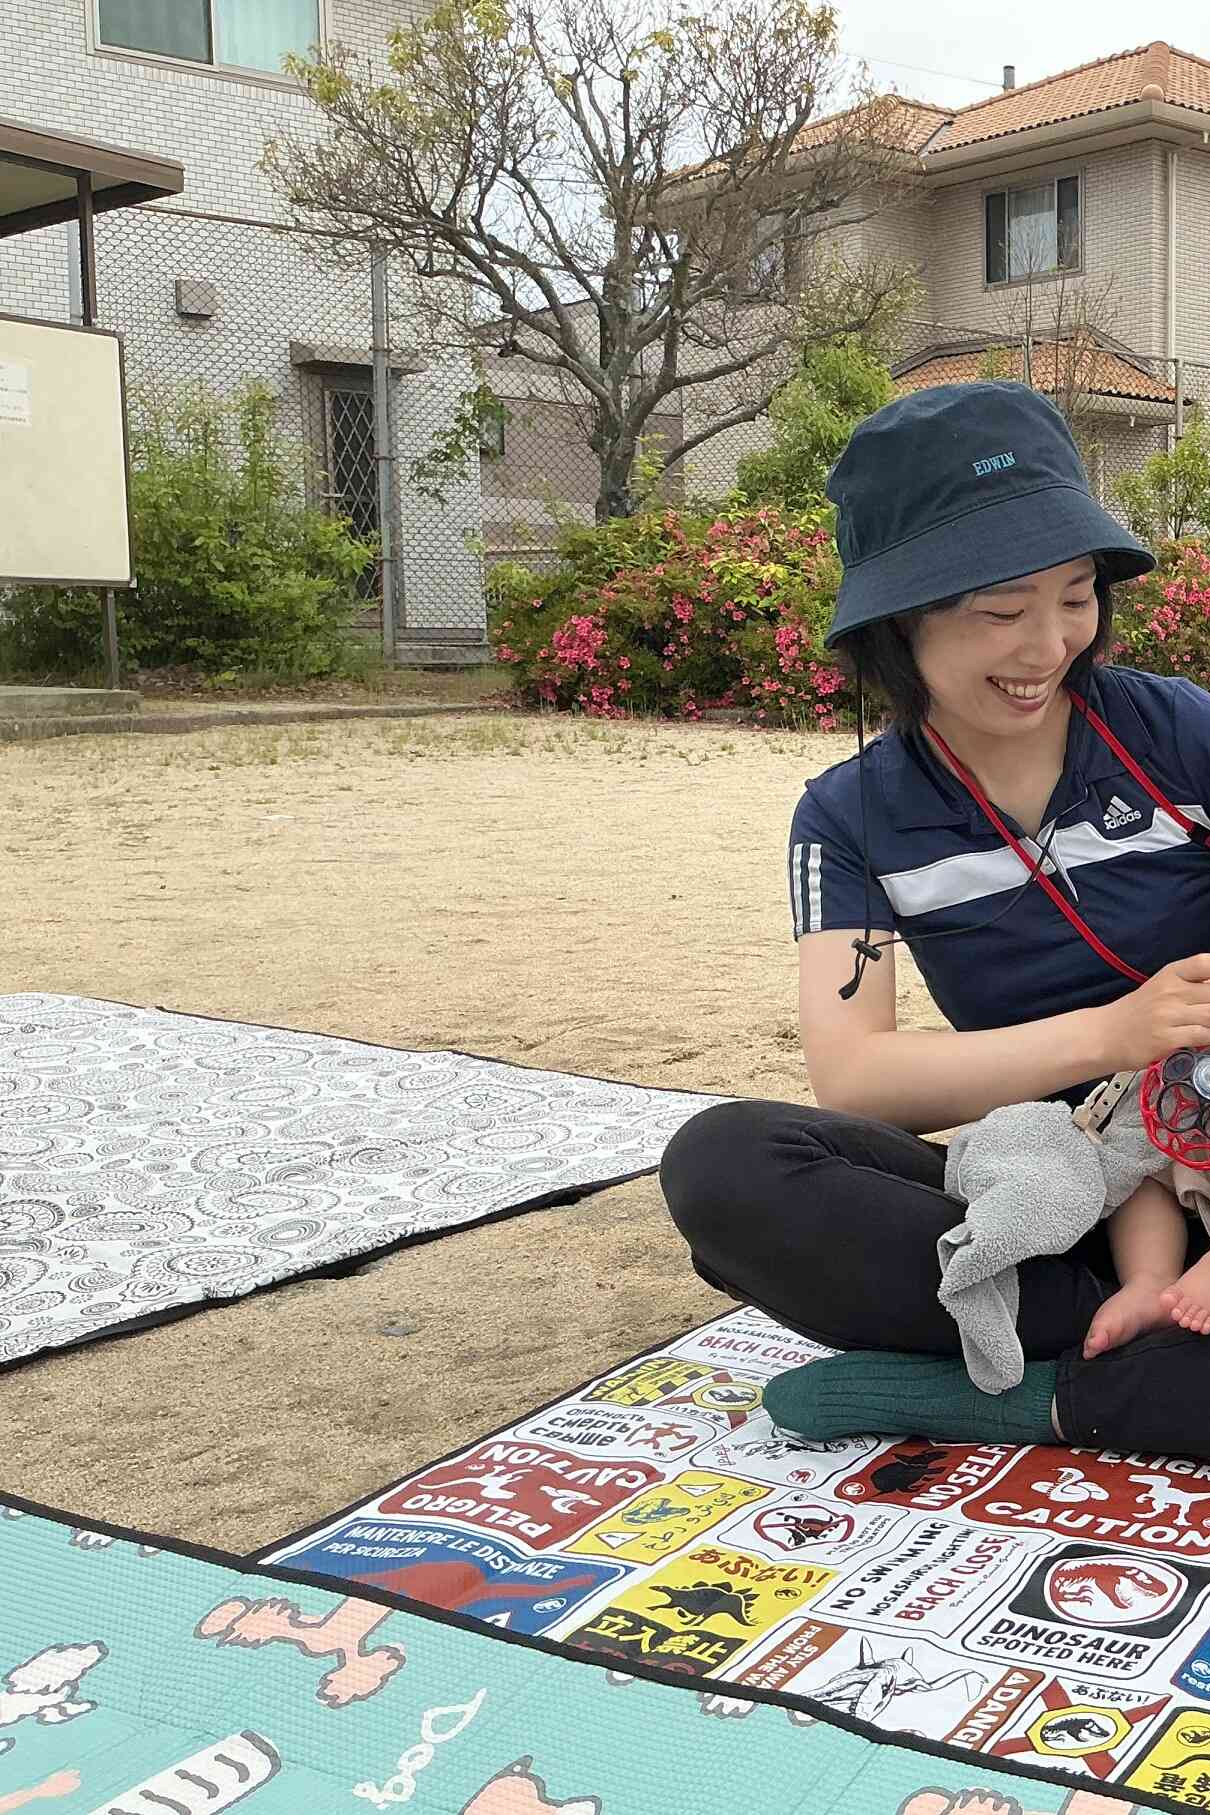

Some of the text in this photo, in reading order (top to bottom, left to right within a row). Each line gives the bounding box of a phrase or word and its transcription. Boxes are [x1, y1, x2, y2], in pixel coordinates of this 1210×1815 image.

[972, 451, 1017, 476] EDWIN
[1103, 809, 1142, 831] adidas
[697, 1335, 761, 1353] BEACH
[479, 1443, 648, 1489] CAUTION
[402, 1493, 553, 1539] PELIGRO
[323, 1544, 356, 1554] PER
[344, 1525, 566, 1580] MANTENERE LE DISTANZE
[688, 1549, 828, 1587] あぶない!
[831, 1587, 866, 1610] NO
[894, 1577, 966, 1621] BEACH
[584, 1615, 728, 1665] 立入禁止
[782, 1625, 823, 1656] FROM
[977, 1635, 1139, 1672] SPOTTED HERE
[990, 1618, 1151, 1659] DINOSAUR
[758, 1654, 790, 1673] THE
[786, 1644, 819, 1668] STAY
[1071, 1684, 1150, 1703] あぶない!
